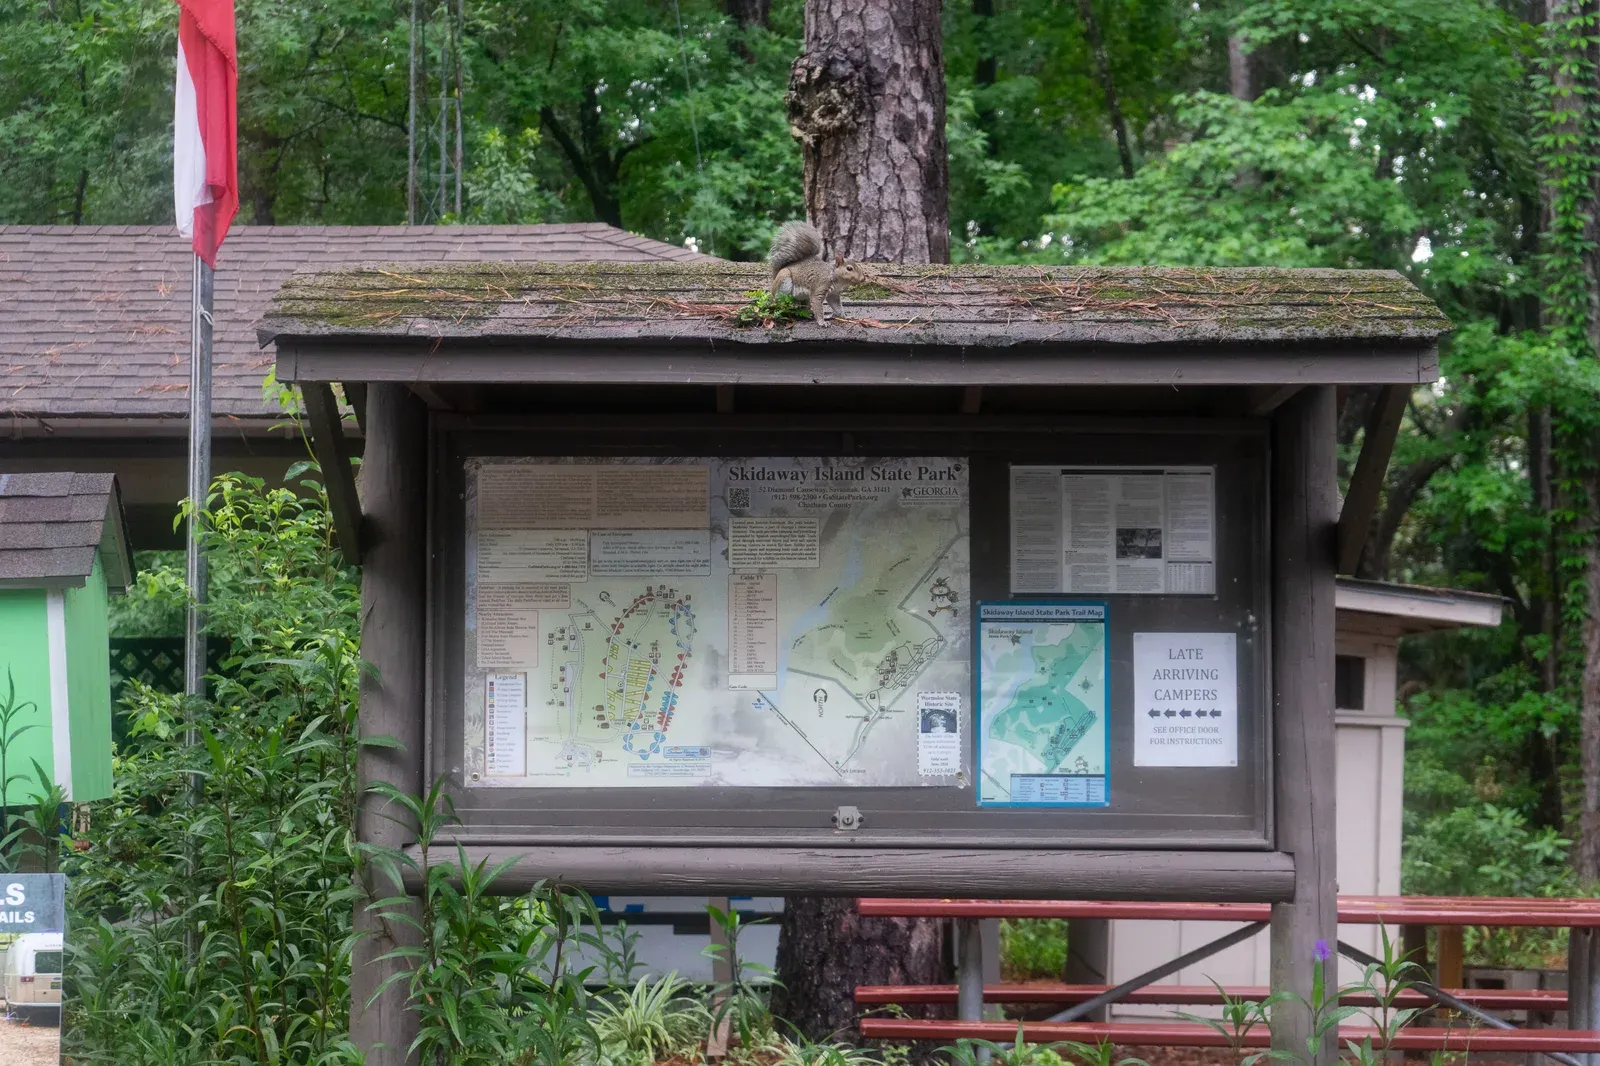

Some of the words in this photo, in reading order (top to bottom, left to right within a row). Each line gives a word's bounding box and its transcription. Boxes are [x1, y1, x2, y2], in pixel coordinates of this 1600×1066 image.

[729, 466, 809, 484] Skidaway
[815, 466, 865, 481] Island
[870, 466, 912, 481] State
[917, 466, 957, 481] Park
[796, 486, 828, 494] Causeway,
[913, 487, 959, 496] GEORGIA
[829, 502, 852, 510] County
[982, 608, 1014, 617] Skidaway
[1015, 608, 1035, 616] Island
[1036, 608, 1054, 616] State
[1055, 608, 1070, 616] Park
[1072, 608, 1086, 616] Trail
[1087, 608, 1103, 617] Map
[1168, 648, 1204, 660] LATE
[1152, 668, 1219, 680] ARRIVING
[1154, 689, 1218, 701] CAMPERS
[1153, 726, 1168, 734] SEE
[1168, 726, 1196, 734] OFFICE
[1197, 726, 1220, 734] DOOR
[1149, 737, 1165, 745] FOR
[1166, 737, 1223, 745] INSTRUCTIONS
